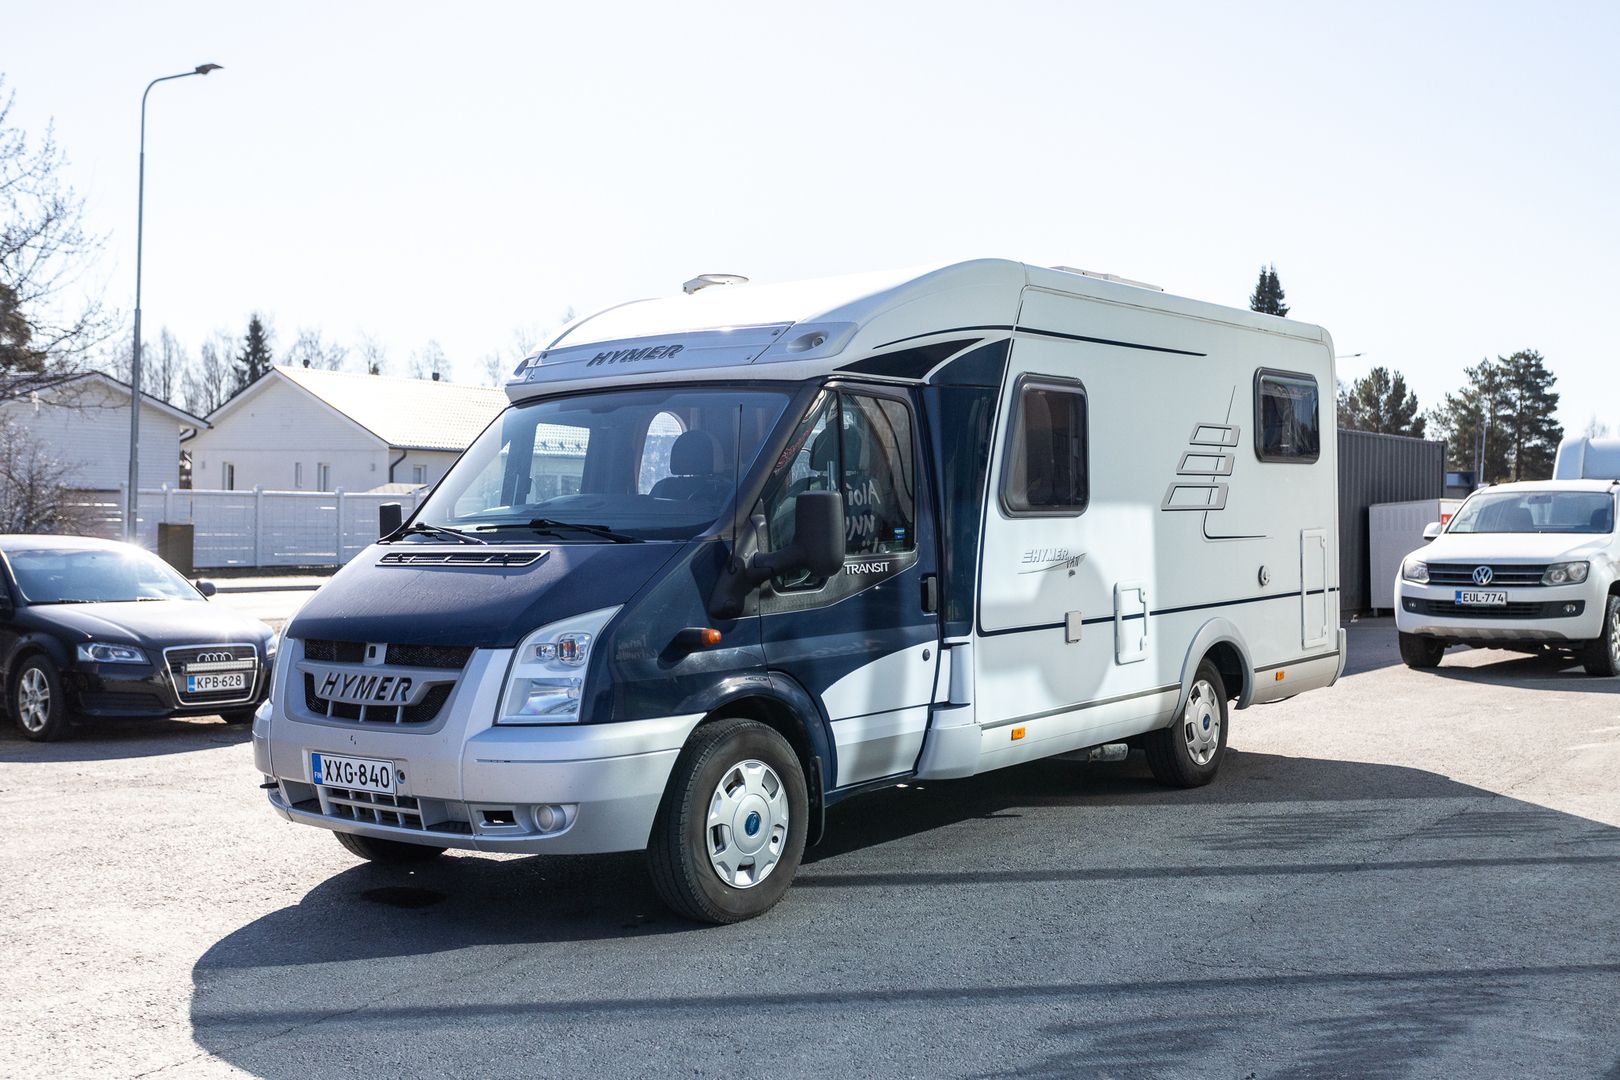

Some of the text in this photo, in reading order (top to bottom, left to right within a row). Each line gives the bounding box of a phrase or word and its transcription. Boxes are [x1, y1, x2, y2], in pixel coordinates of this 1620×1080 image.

[586, 344, 684, 367] HYMER
[1030, 548, 1069, 563] HYMER
[845, 562, 890, 575] TRANSIT
[1463, 593, 1504, 603] EUL-774
[197, 675, 242, 689] KPB-628
[319, 672, 412, 702] HYMER
[324, 759, 390, 788] XXG-840
